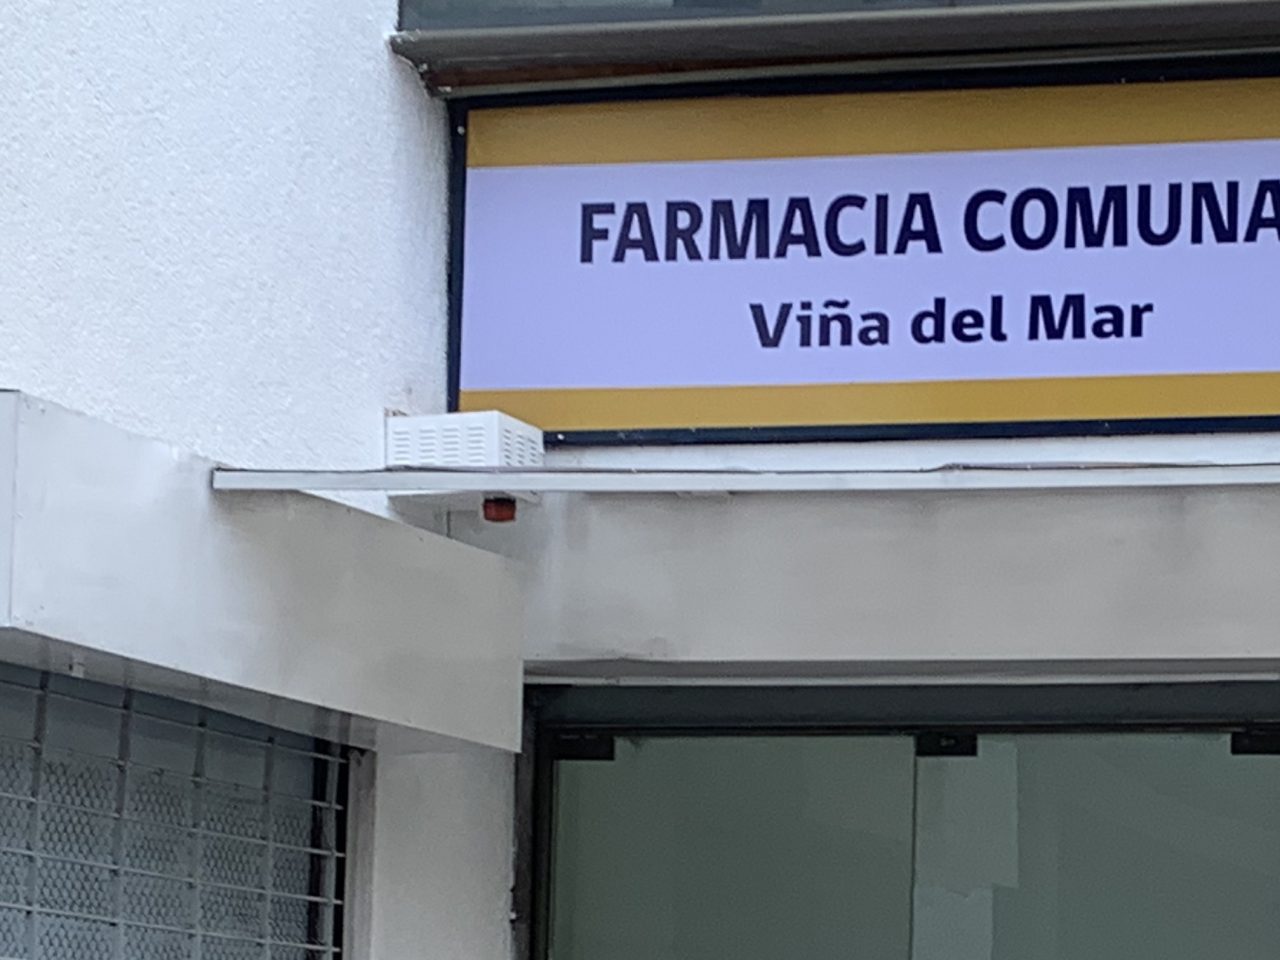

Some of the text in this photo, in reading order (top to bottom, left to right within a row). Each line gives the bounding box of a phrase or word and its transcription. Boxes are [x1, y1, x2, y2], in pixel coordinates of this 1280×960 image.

[579, 191, 943, 264] FARMACIA
[749, 293, 1154, 349] Viña del Mar
